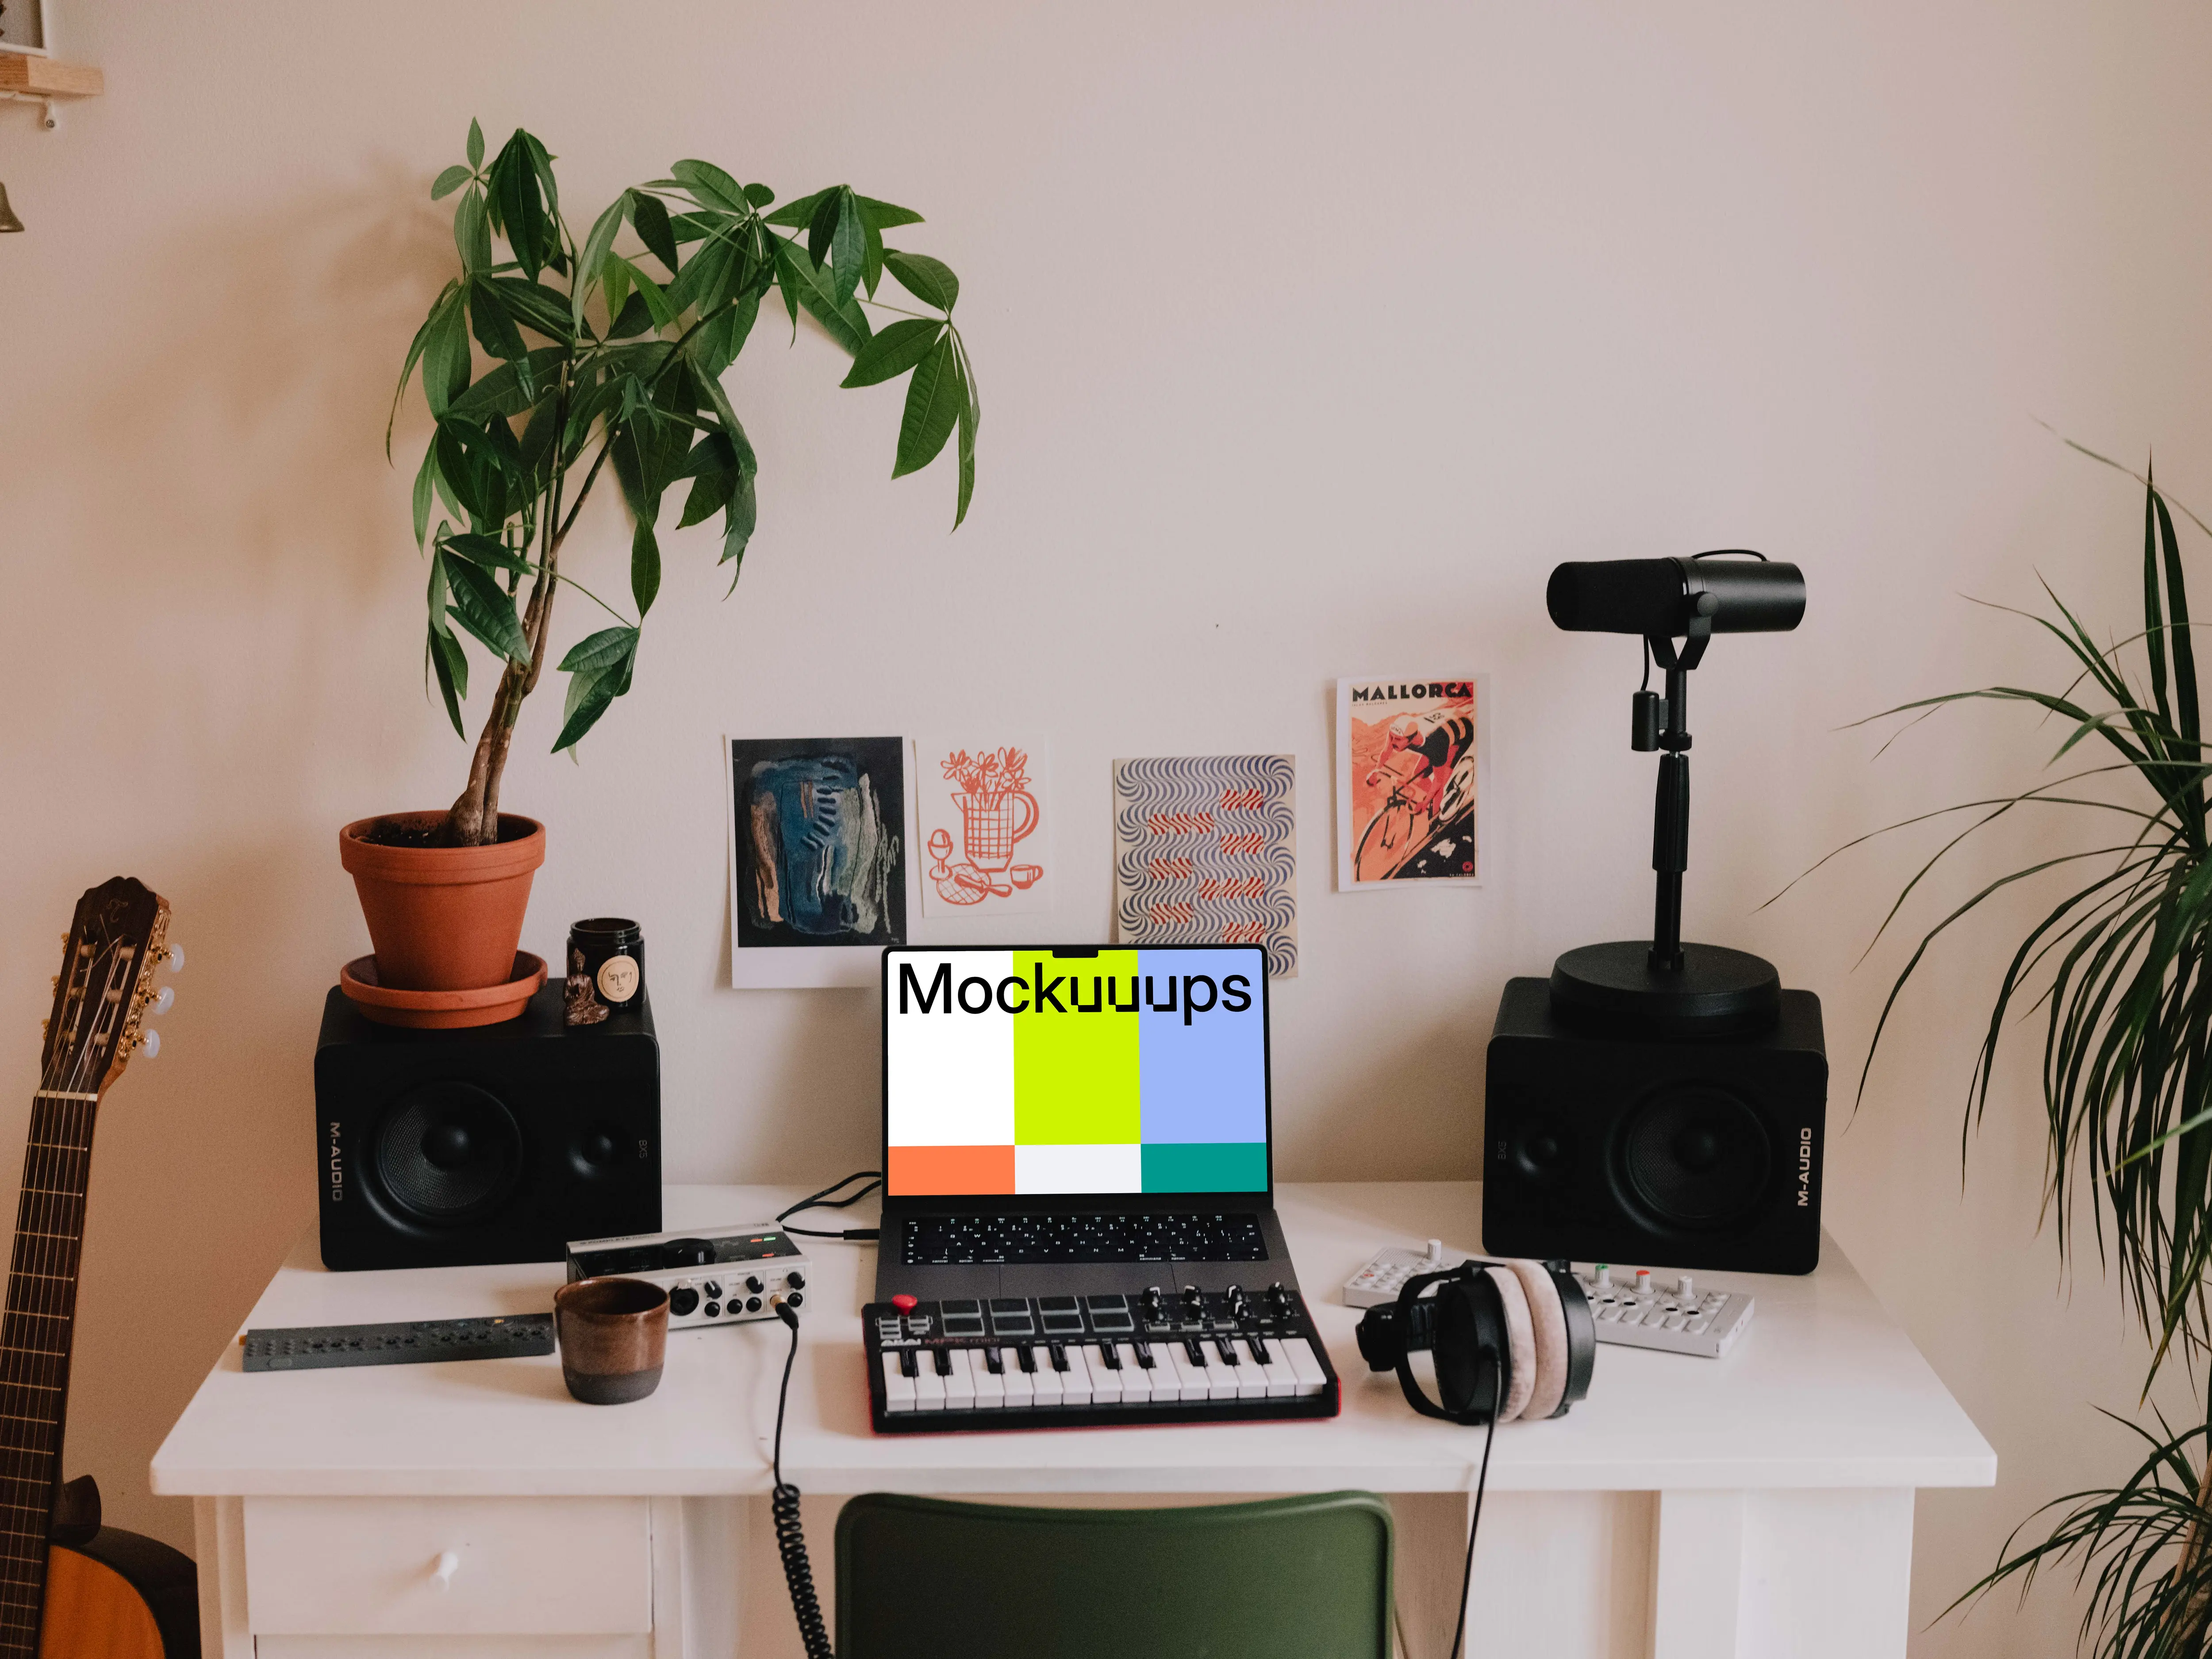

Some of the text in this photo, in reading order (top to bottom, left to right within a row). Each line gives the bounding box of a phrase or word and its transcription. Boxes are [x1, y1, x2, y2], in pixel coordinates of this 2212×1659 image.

[1352, 683, 1471, 702] MALLORCA
[899, 962, 1252, 1026] Mockuuups
[330, 1121, 343, 1202] M-AUDIO
[638, 1140, 647, 1159] BX5
[1498, 1140, 1507, 1160] BX5
[1797, 1127, 1812, 1206] M-AUDIO
